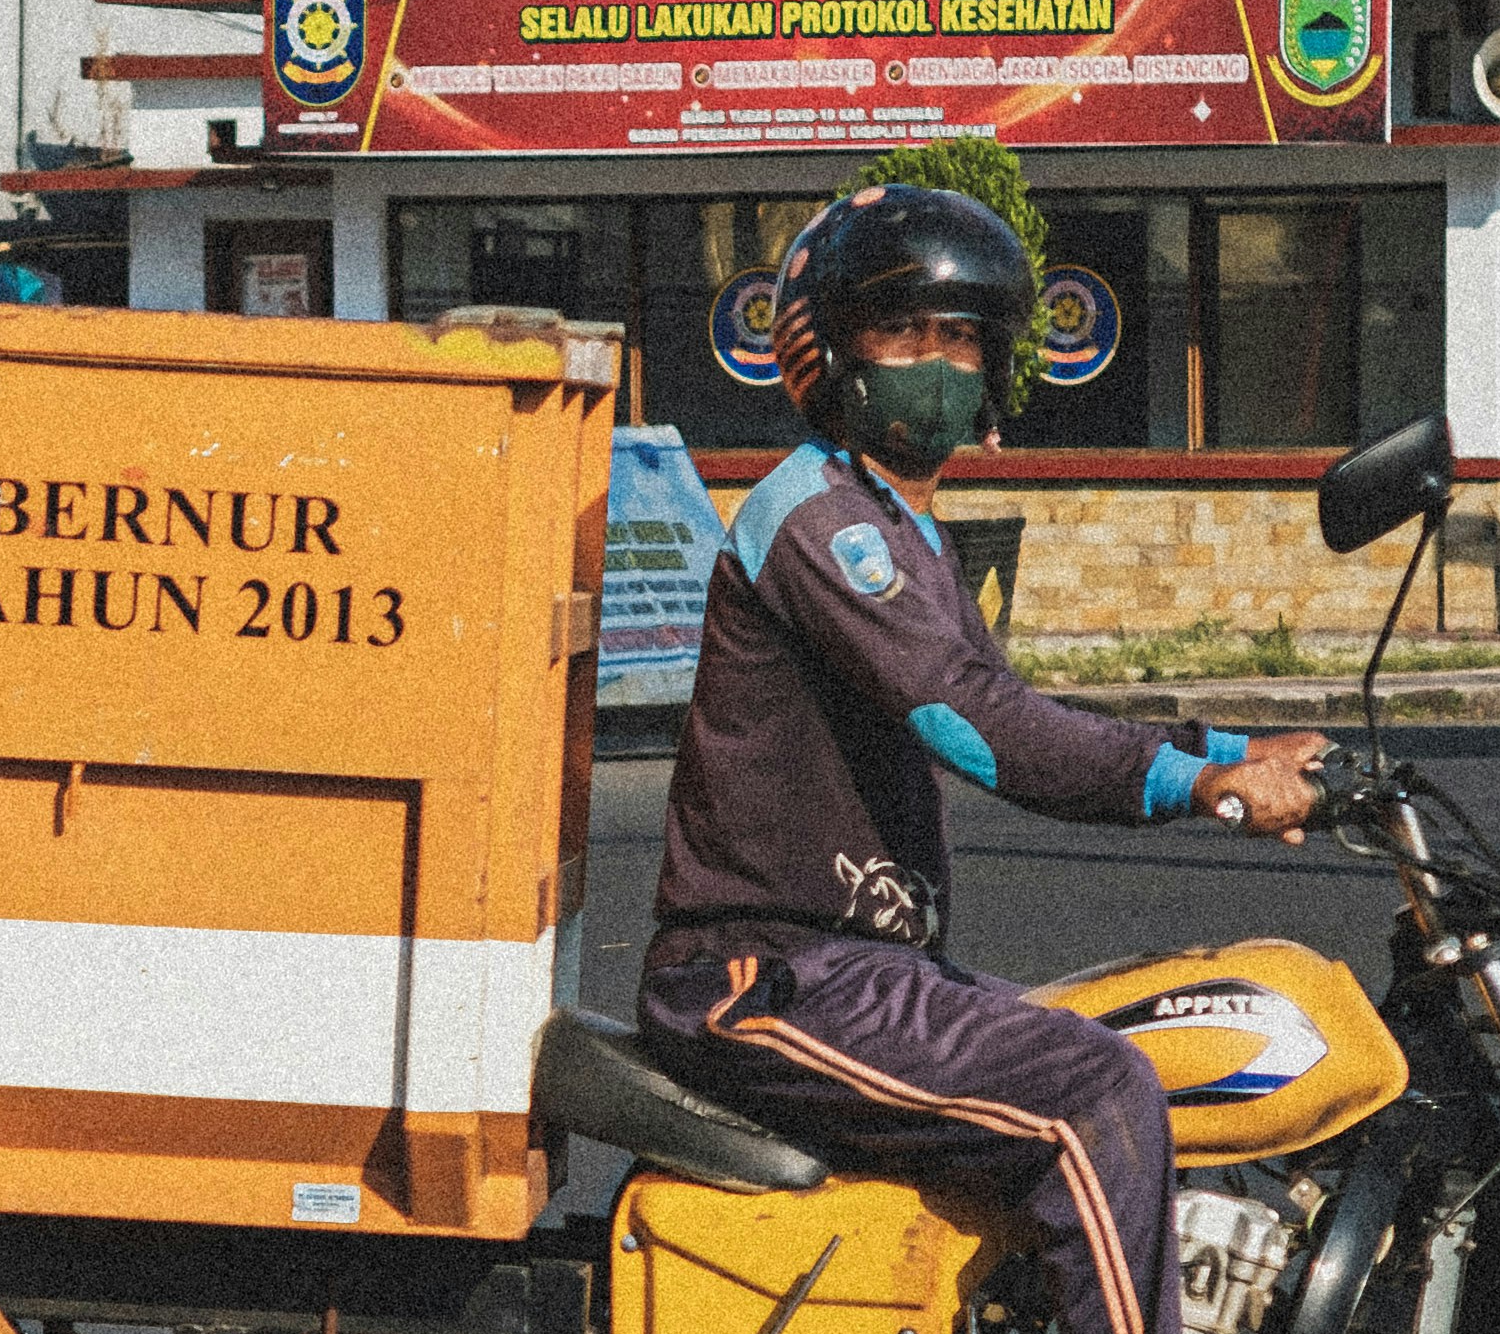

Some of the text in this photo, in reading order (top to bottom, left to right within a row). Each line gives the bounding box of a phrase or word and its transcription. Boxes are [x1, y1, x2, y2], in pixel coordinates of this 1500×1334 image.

[521, 4, 627, 40] SELALU
[637, 3, 773, 38] LAKUKAN
[782, 0, 932, 35] PROTOKOL
[621, 64, 680, 88] SABUN
[802, 60, 875, 85] MASKER
[911, 59, 997, 84] MENJAGA
[236, 578, 405, 647] 2013
